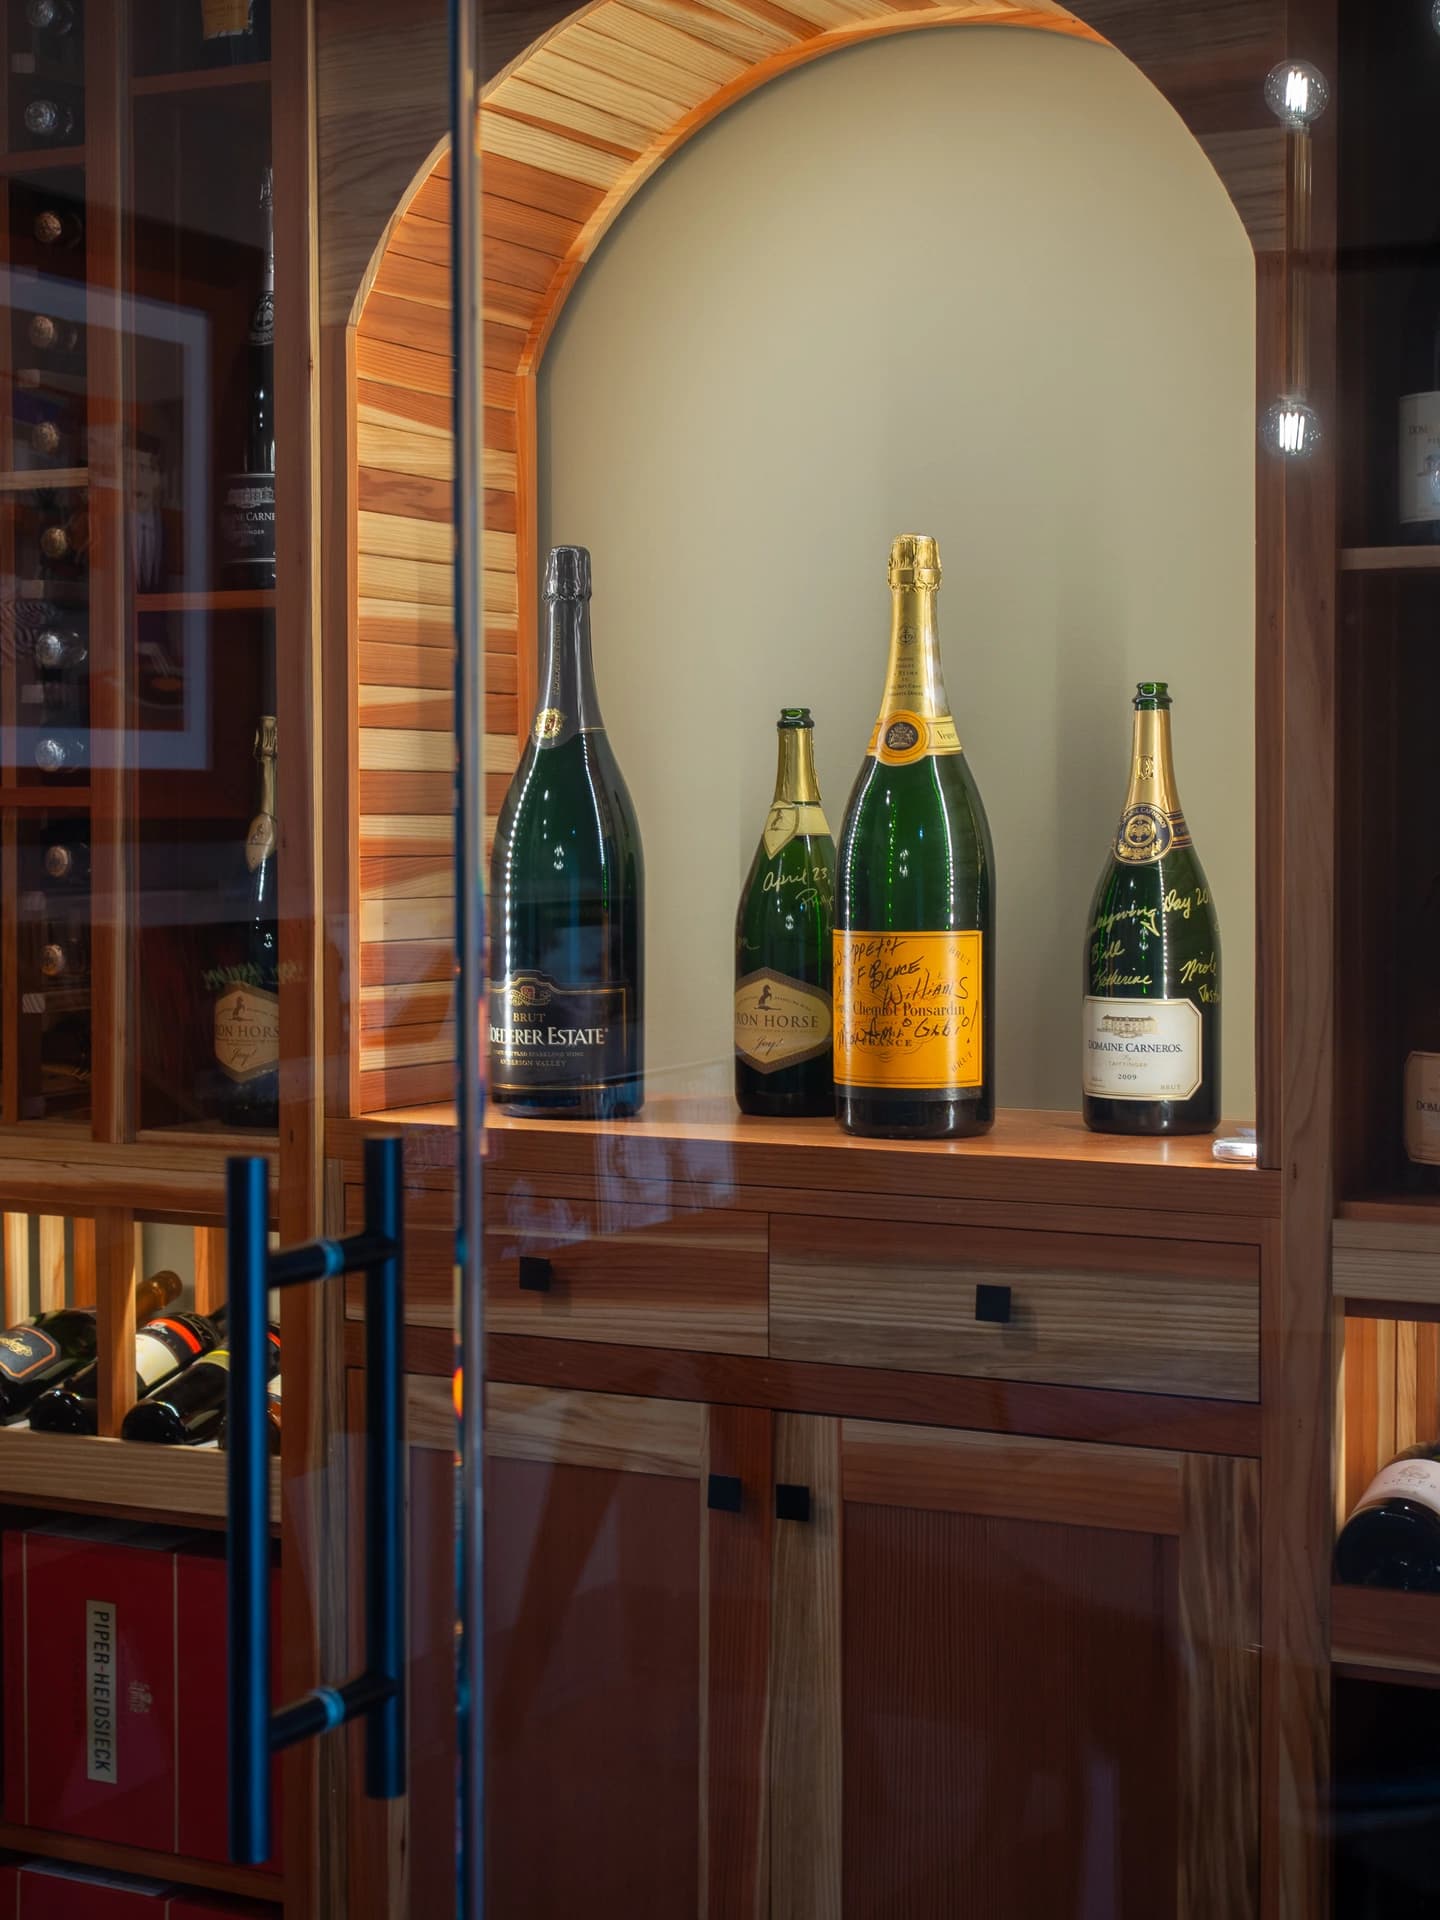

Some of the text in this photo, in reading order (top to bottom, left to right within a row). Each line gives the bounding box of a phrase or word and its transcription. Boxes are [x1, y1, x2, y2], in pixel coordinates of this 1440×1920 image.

[903, 1002, 966, 1017] Ponsardin
[513, 1012, 546, 1023] BRUT
[764, 1015, 819, 1029] HORSE
[547, 1027, 605, 1045] ESTATE
[1117, 1073, 1138, 1081] 2009
